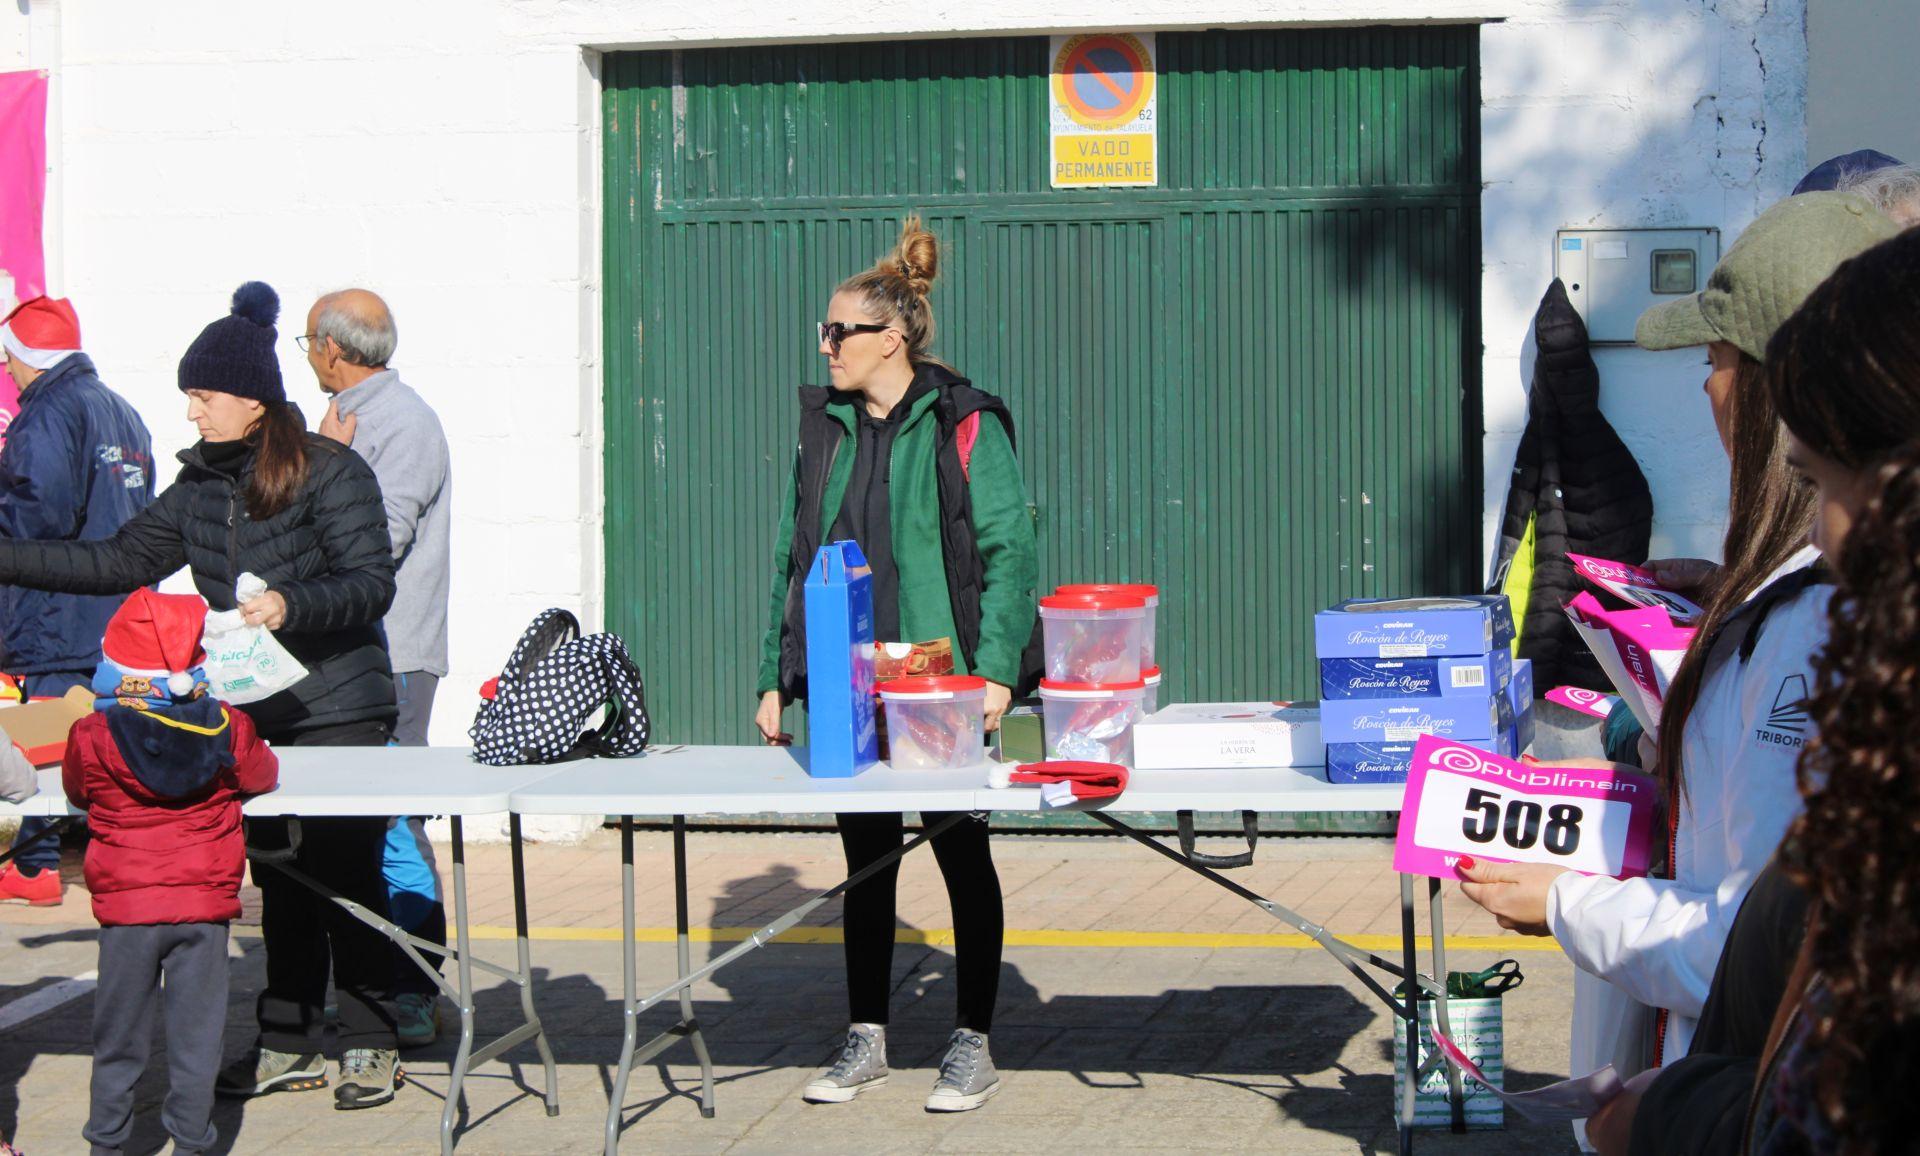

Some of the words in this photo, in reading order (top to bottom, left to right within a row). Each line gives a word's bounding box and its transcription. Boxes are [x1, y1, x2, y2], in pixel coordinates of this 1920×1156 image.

[1139, 109, 1153, 121] 62
[1078, 140, 1129, 156] VADO
[1056, 161, 1153, 178] PERMANENTE
[1347, 625, 1390, 645] Roscón
[1395, 630, 1408, 643] de
[1410, 629, 1449, 649] Reyes
[1349, 673, 1385, 688] Roscón
[1386, 678, 1397, 688] de
[1399, 675, 1431, 693] Reyes
[1400, 716, 1414, 729] de
[1416, 714, 1455, 734] Reyes
[1234, 746, 1256, 754] VERA
[1355, 757, 1391, 773] Roscón
[1393, 761, 1404, 771] de
[1481, 761, 1638, 793] publimain
[1462, 788, 1584, 856] 508
